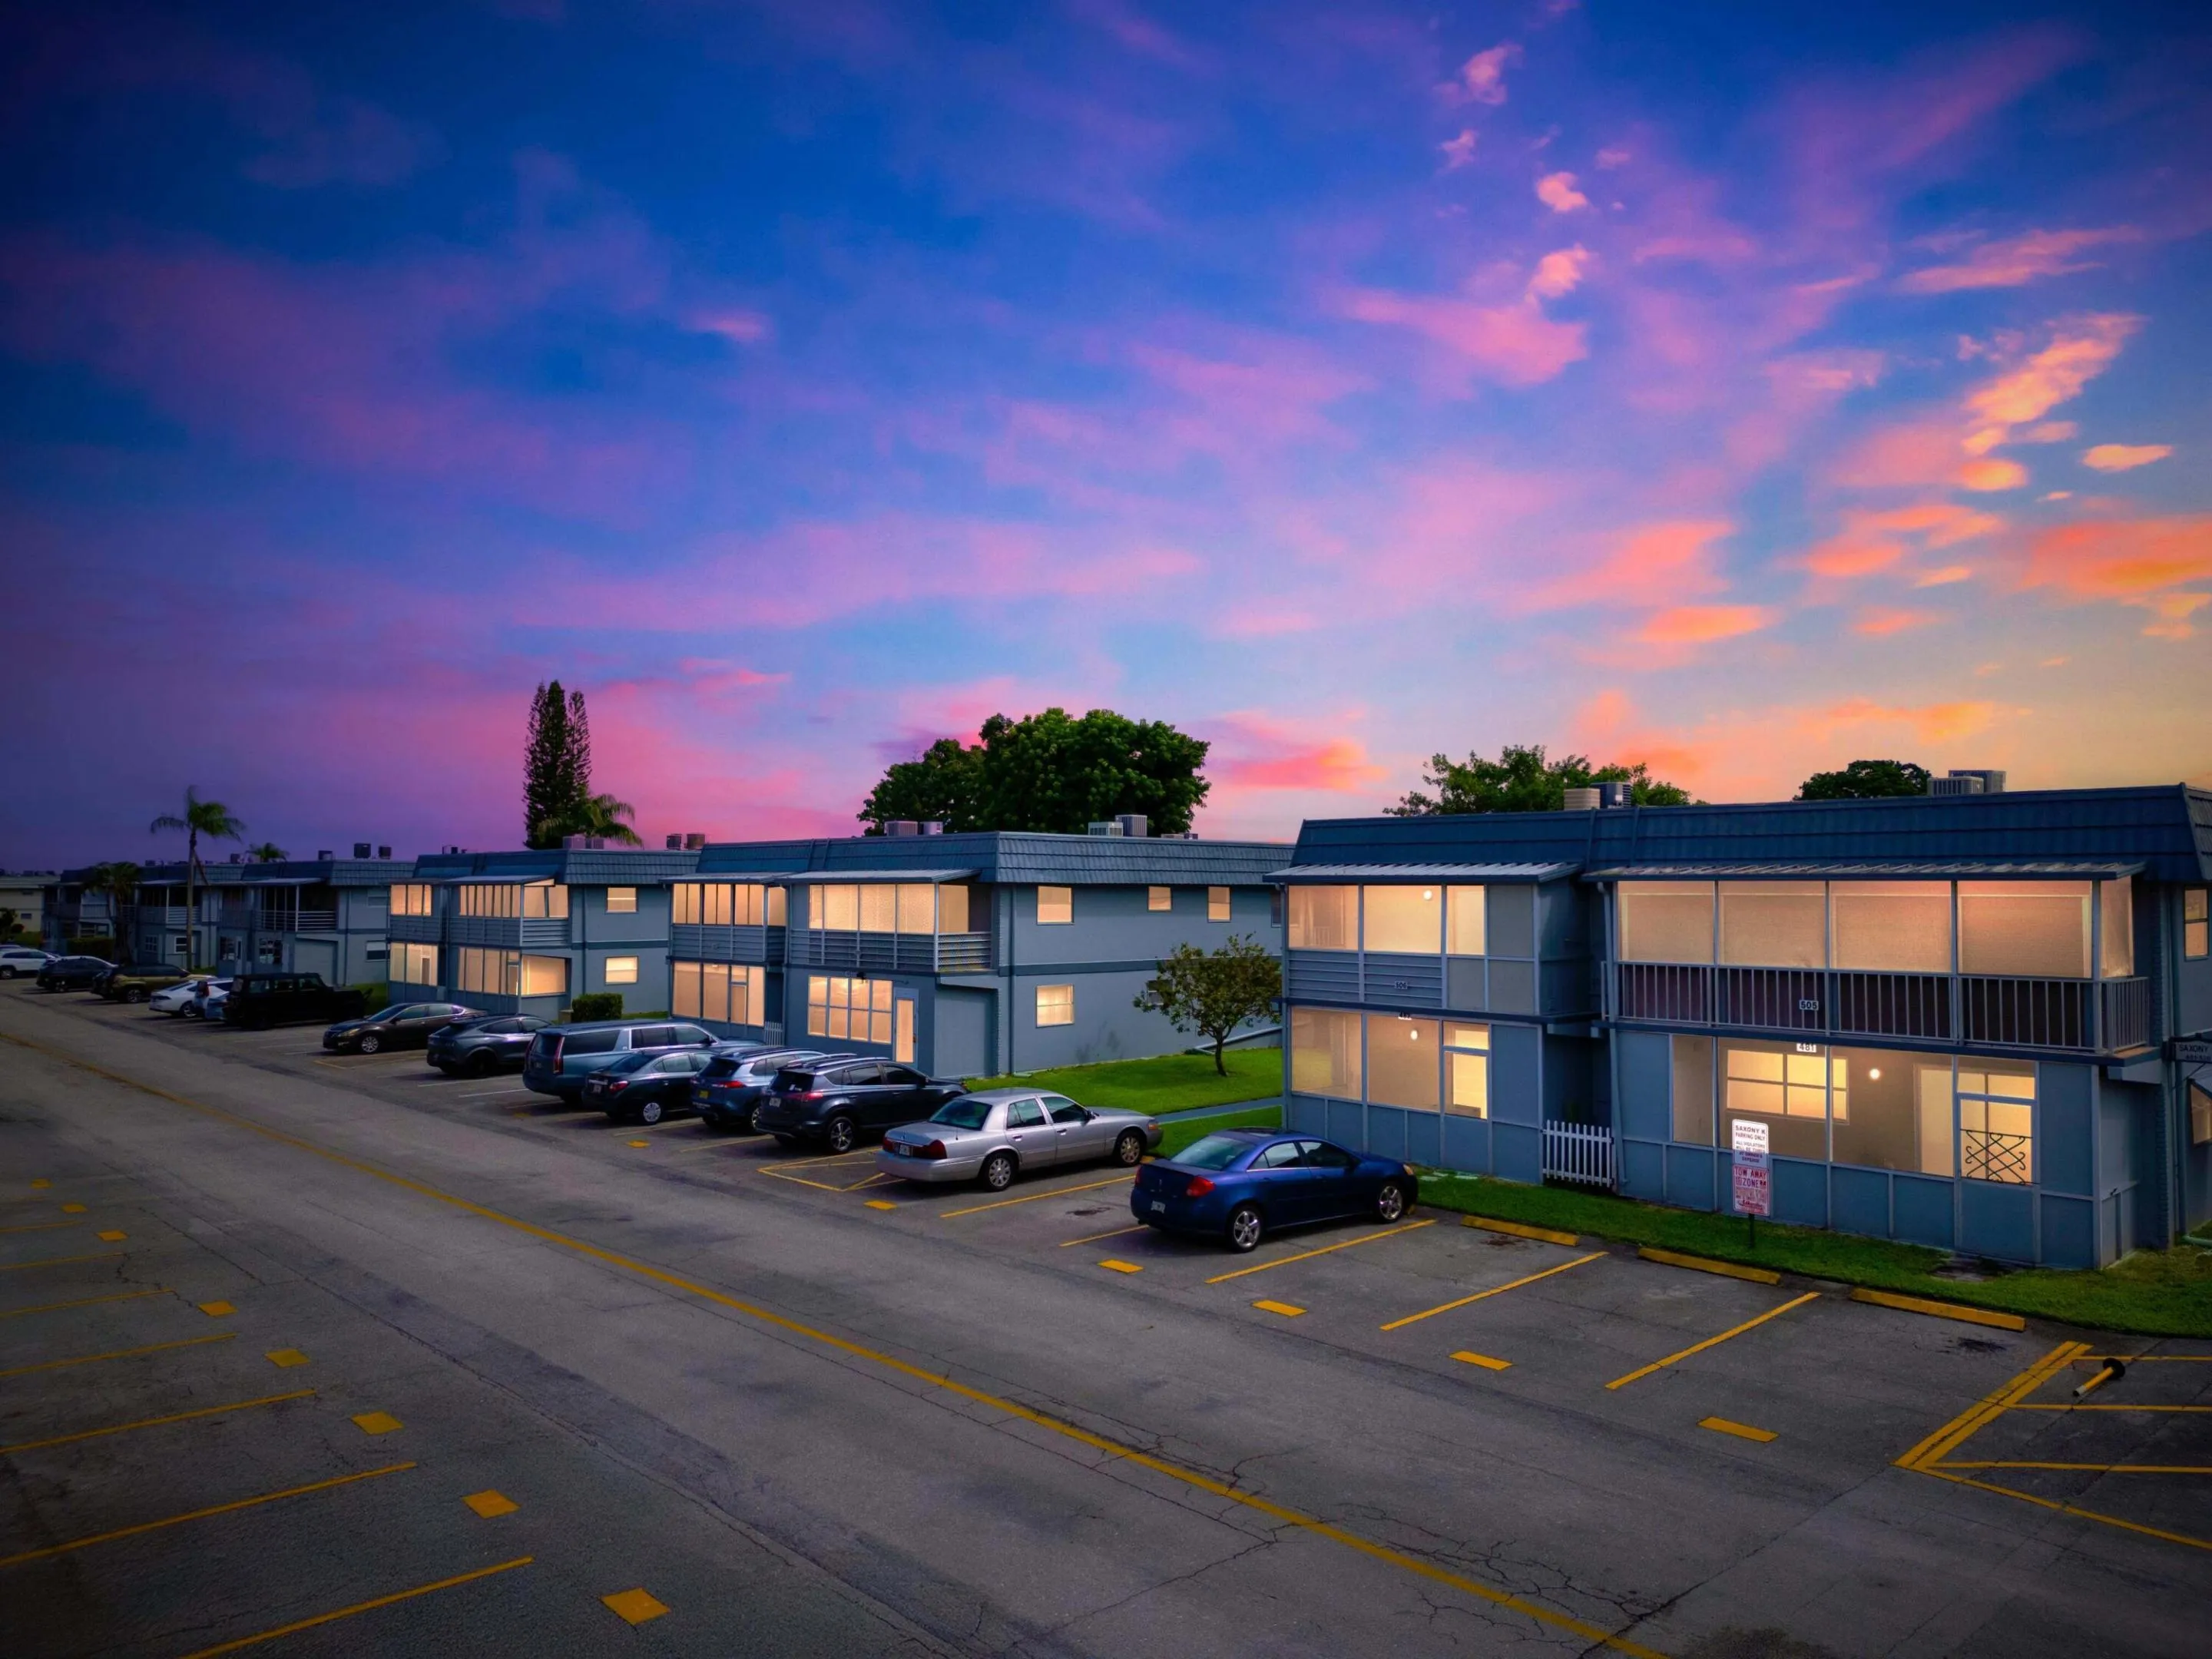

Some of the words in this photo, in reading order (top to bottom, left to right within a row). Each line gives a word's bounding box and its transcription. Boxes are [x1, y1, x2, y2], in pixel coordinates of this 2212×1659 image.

[1800, 1001, 1817, 1009] 505
[1734, 1167, 1747, 1177] TOW
[1750, 1170, 1767, 1179] AWAY
[1743, 1178, 1759, 1188] ZONE
